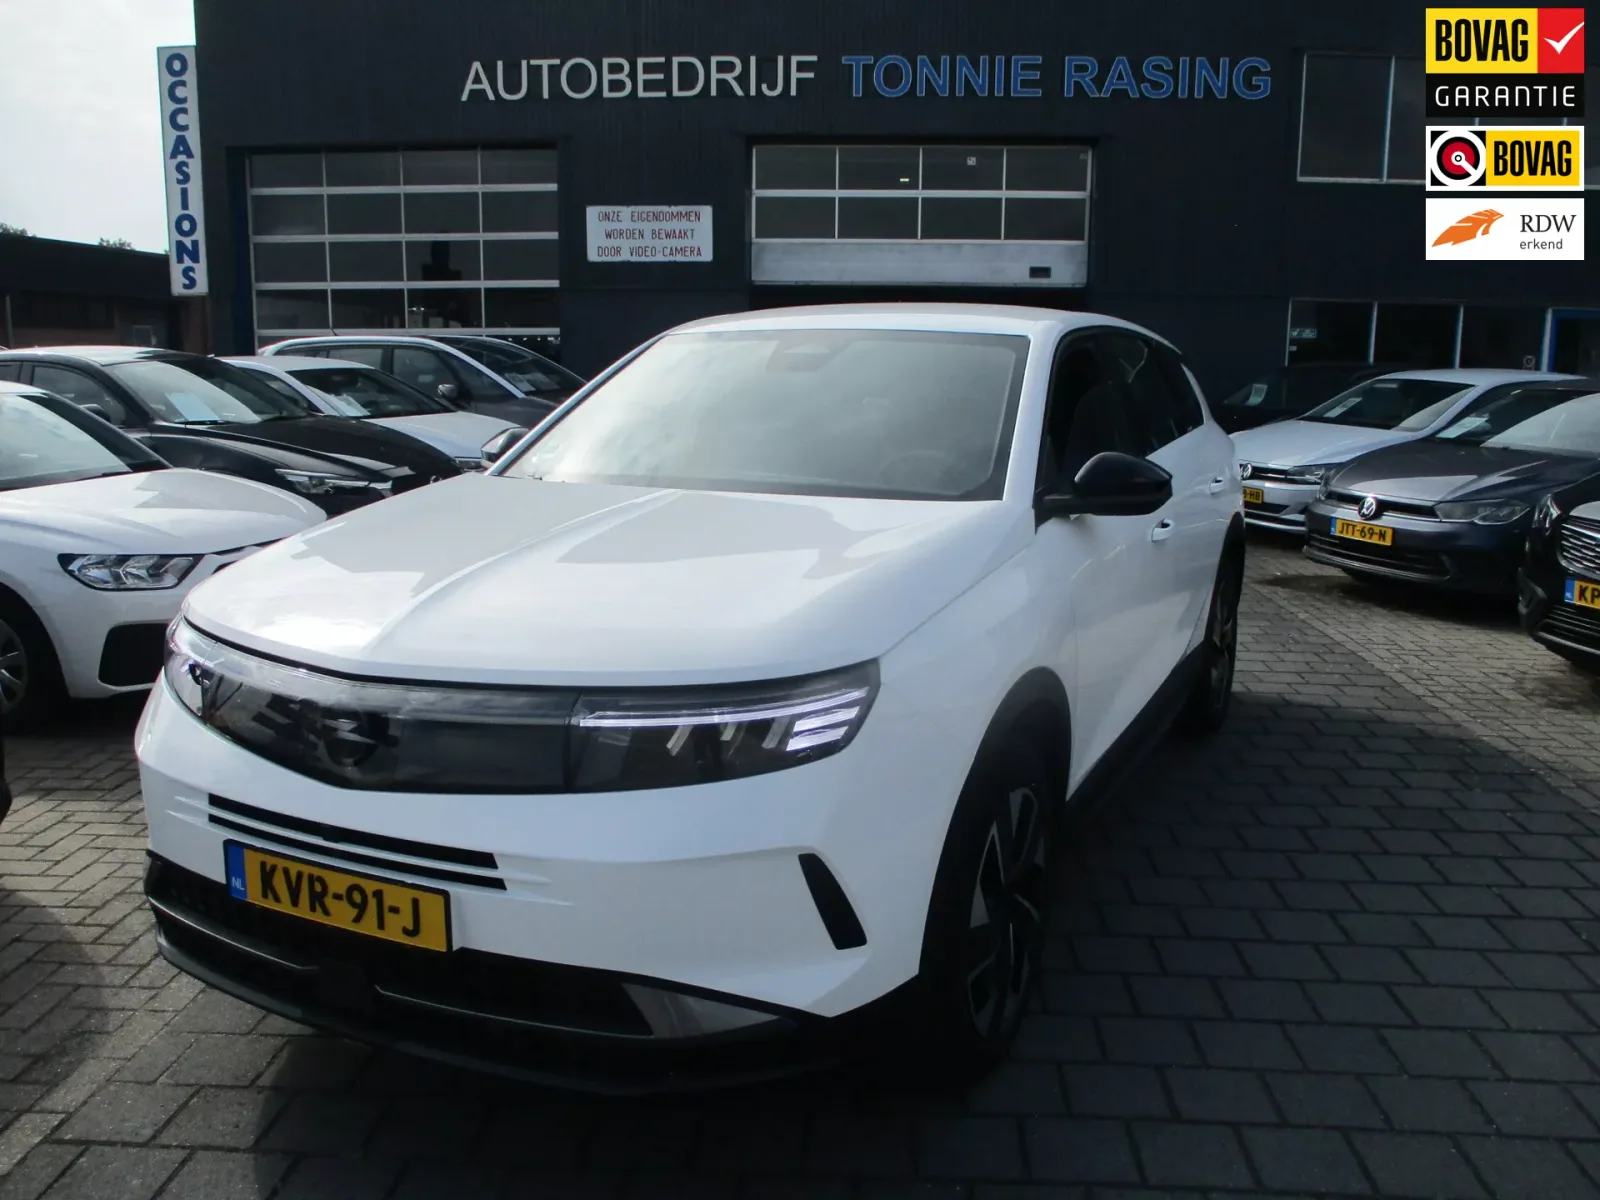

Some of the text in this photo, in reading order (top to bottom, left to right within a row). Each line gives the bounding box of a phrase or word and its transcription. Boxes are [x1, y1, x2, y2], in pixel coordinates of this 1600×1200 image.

[461, 55, 1272, 101] AUTOBEDRIJF TONNIE RASING
[165, 52, 200, 290] OCCASIONS
[598, 211, 701, 222] ONZE EIGENDOMMEN
[605, 229, 695, 240] WORDEN BEWAAKT
[597, 246, 702, 257] DOOR VIDEO-CAMERA
[1338, 522, 1386, 541] JTT-69-N
[231, 860, 420, 938] NL KVR-91-J
